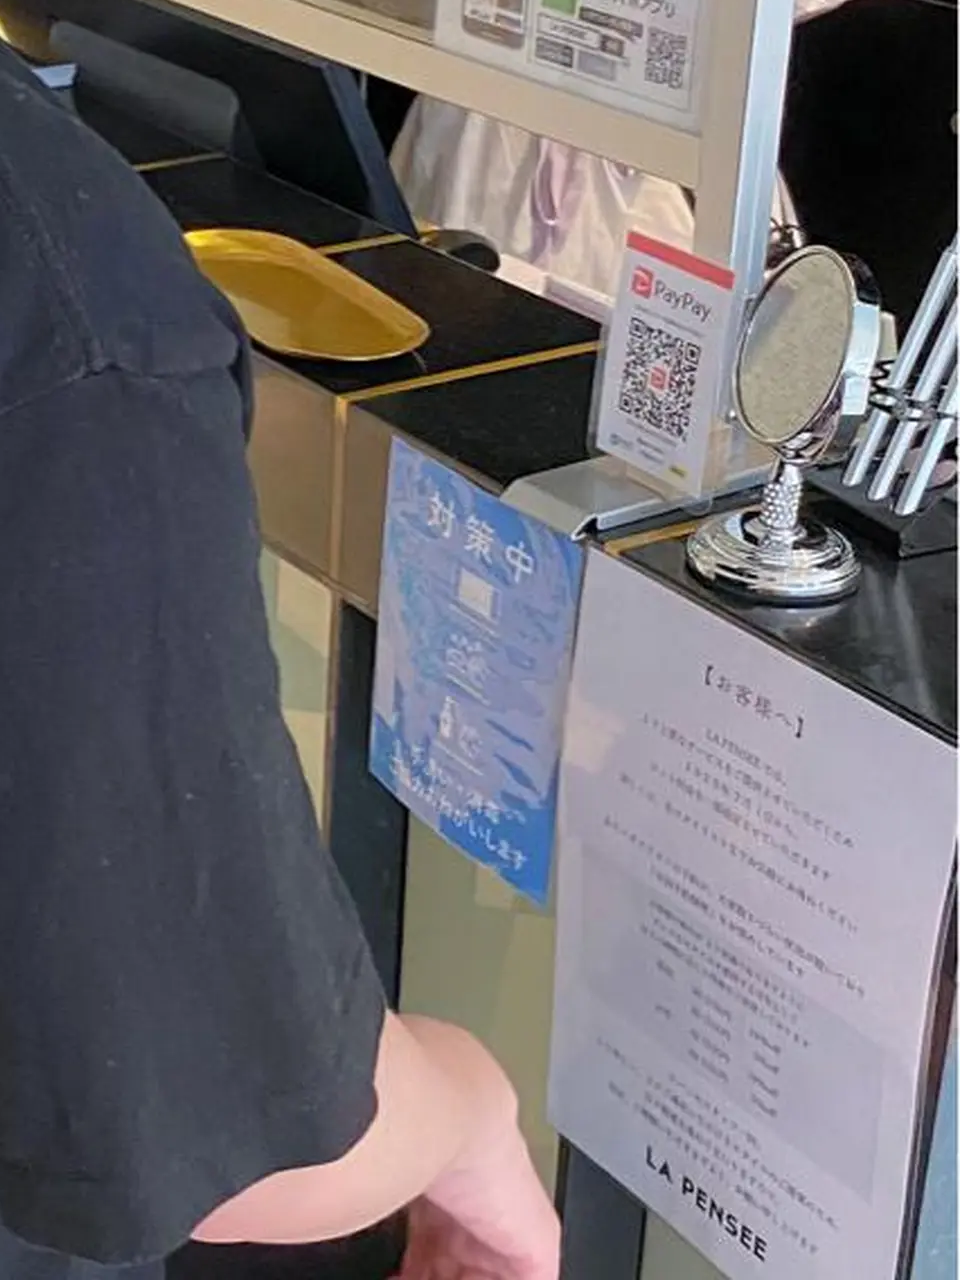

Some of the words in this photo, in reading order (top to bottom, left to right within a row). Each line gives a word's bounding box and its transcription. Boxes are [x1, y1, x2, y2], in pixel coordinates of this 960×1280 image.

[653, 279, 712, 323] PayPay
[426, 494, 536, 585] 対策中
[702, 663, 805, 739] 【お客様へ】
[645, 1144, 675, 1186] LA
[681, 1176, 768, 1262] PENSEE
